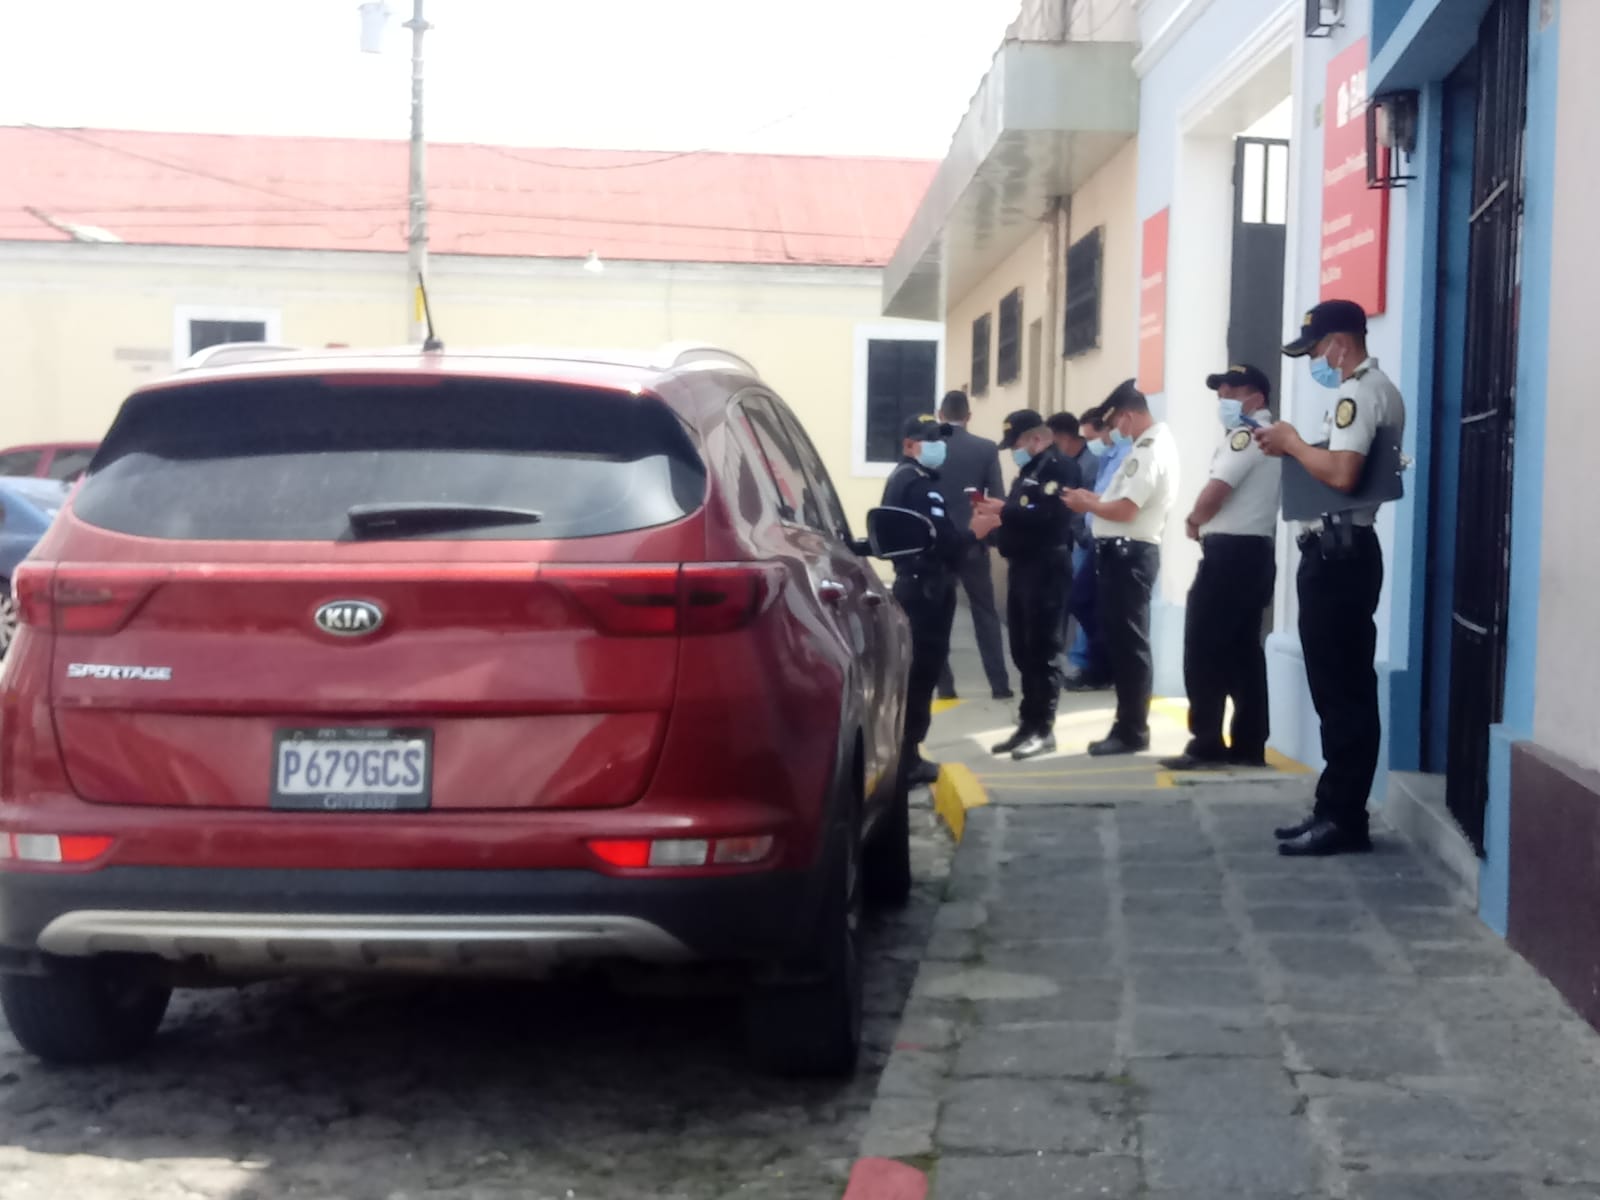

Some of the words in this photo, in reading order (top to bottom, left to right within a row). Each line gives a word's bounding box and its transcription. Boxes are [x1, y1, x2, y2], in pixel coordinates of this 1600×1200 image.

[324, 606, 371, 628] KIA
[67, 662, 173, 681] SPORTAGE
[283, 749, 421, 787] P679GCS
